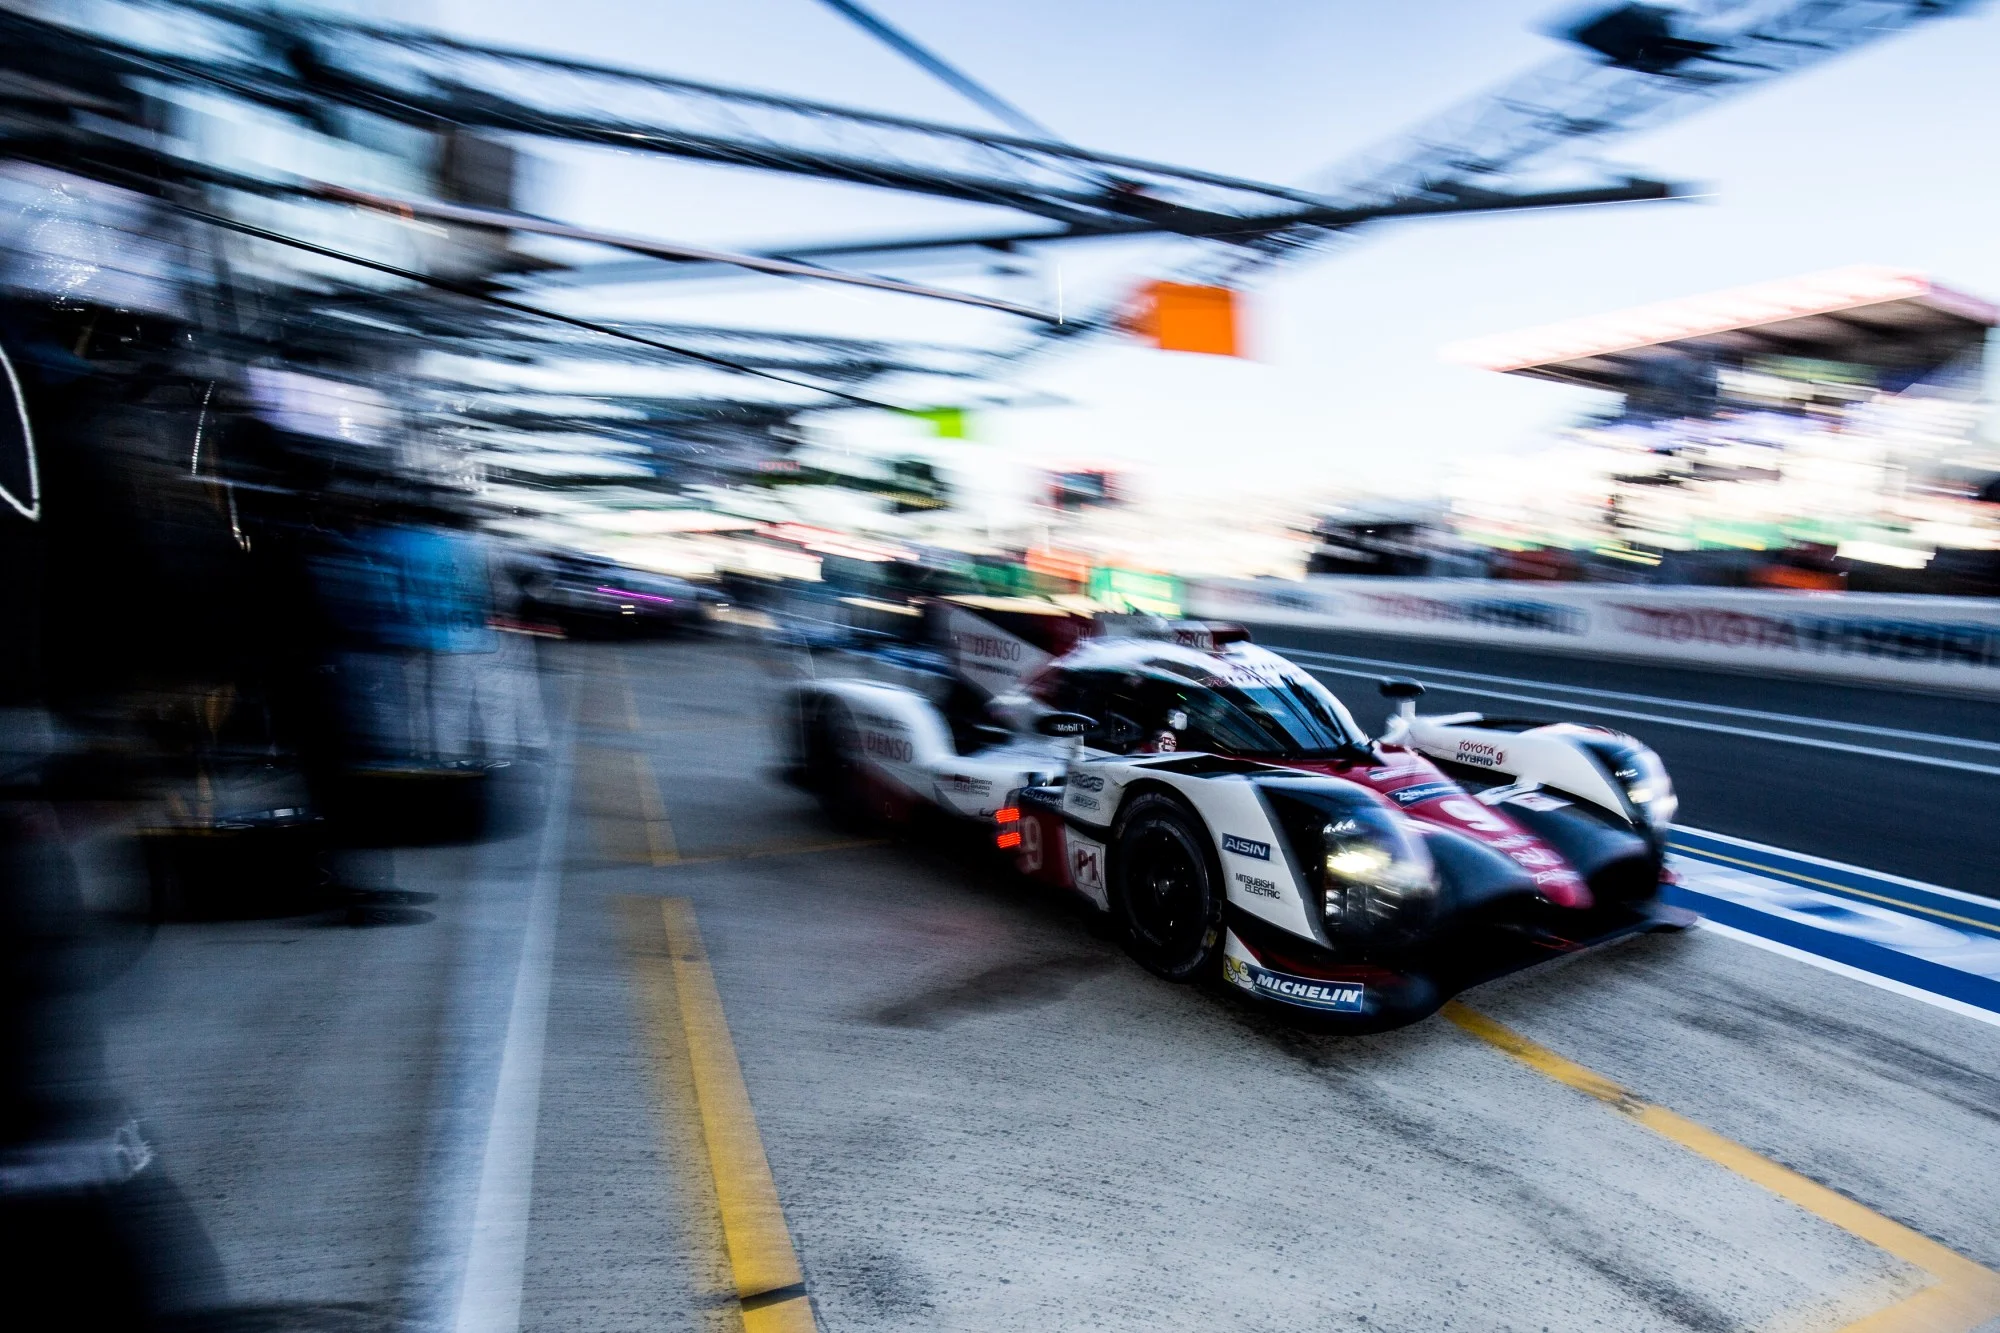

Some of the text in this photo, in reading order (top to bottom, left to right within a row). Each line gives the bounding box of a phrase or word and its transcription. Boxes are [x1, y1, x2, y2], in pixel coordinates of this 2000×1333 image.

[974, 636, 1021, 661] DENSO
[1057, 723, 1078, 732] Mobil
[866, 730, 914, 763] DENSO
[1459, 741, 1494, 756] TOYOTA
[1456, 752, 1494, 766] HYBRID
[1495, 751, 1503, 765] 9
[1437, 799, 1511, 833] 9
[1225, 838, 1266, 857] AISIN
[1077, 848, 1097, 881] P1
[1235, 872, 1275, 890] MITSUBISHI
[1245, 883, 1281, 899] ELECTRIC
[1256, 973, 1361, 1003] MICHELIN
